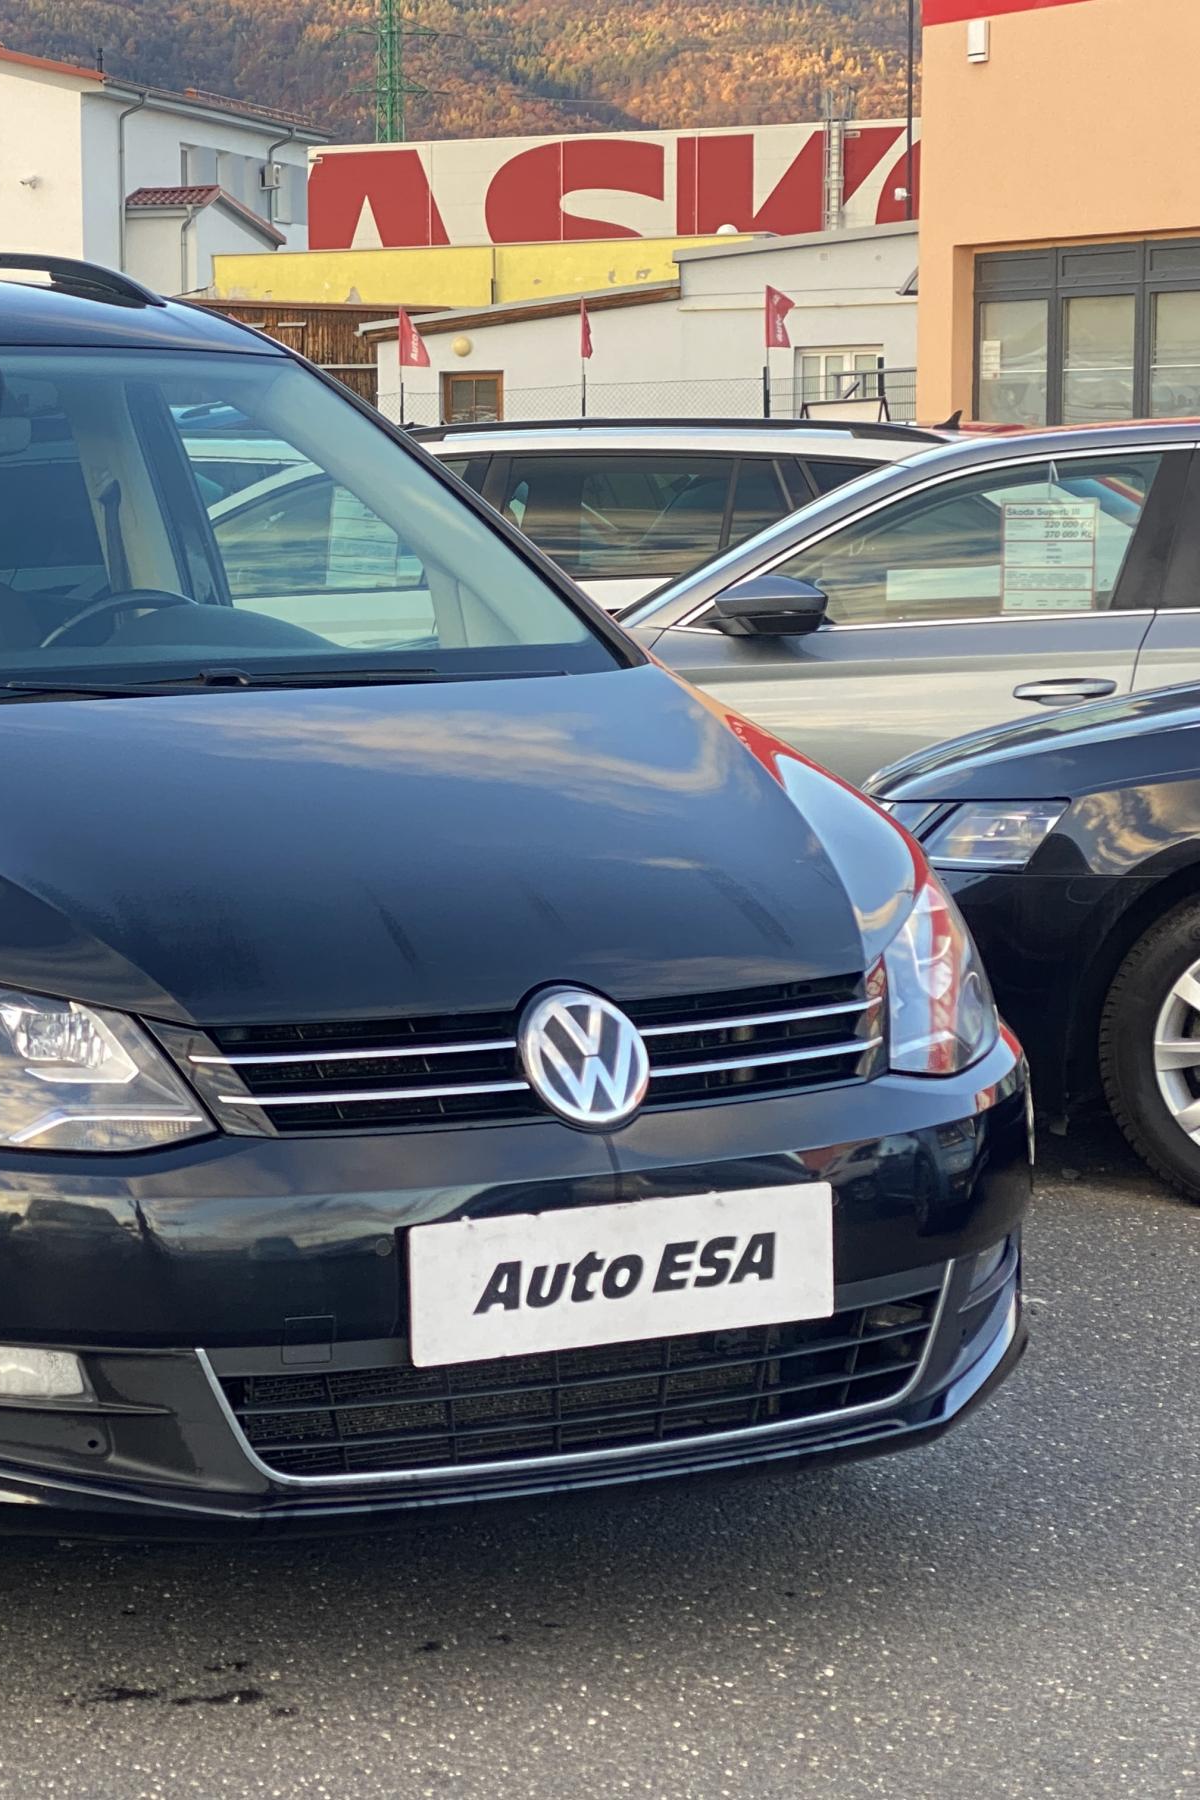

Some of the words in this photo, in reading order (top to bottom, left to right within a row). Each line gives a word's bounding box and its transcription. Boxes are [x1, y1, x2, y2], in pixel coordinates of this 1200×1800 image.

[308, 126, 920, 249] ASK
[409, 333, 419, 362] Auto
[1062, 530, 1079, 539] 000
[473, 1251, 644, 1315] Auto
[652, 1231, 776, 1293] ESA
